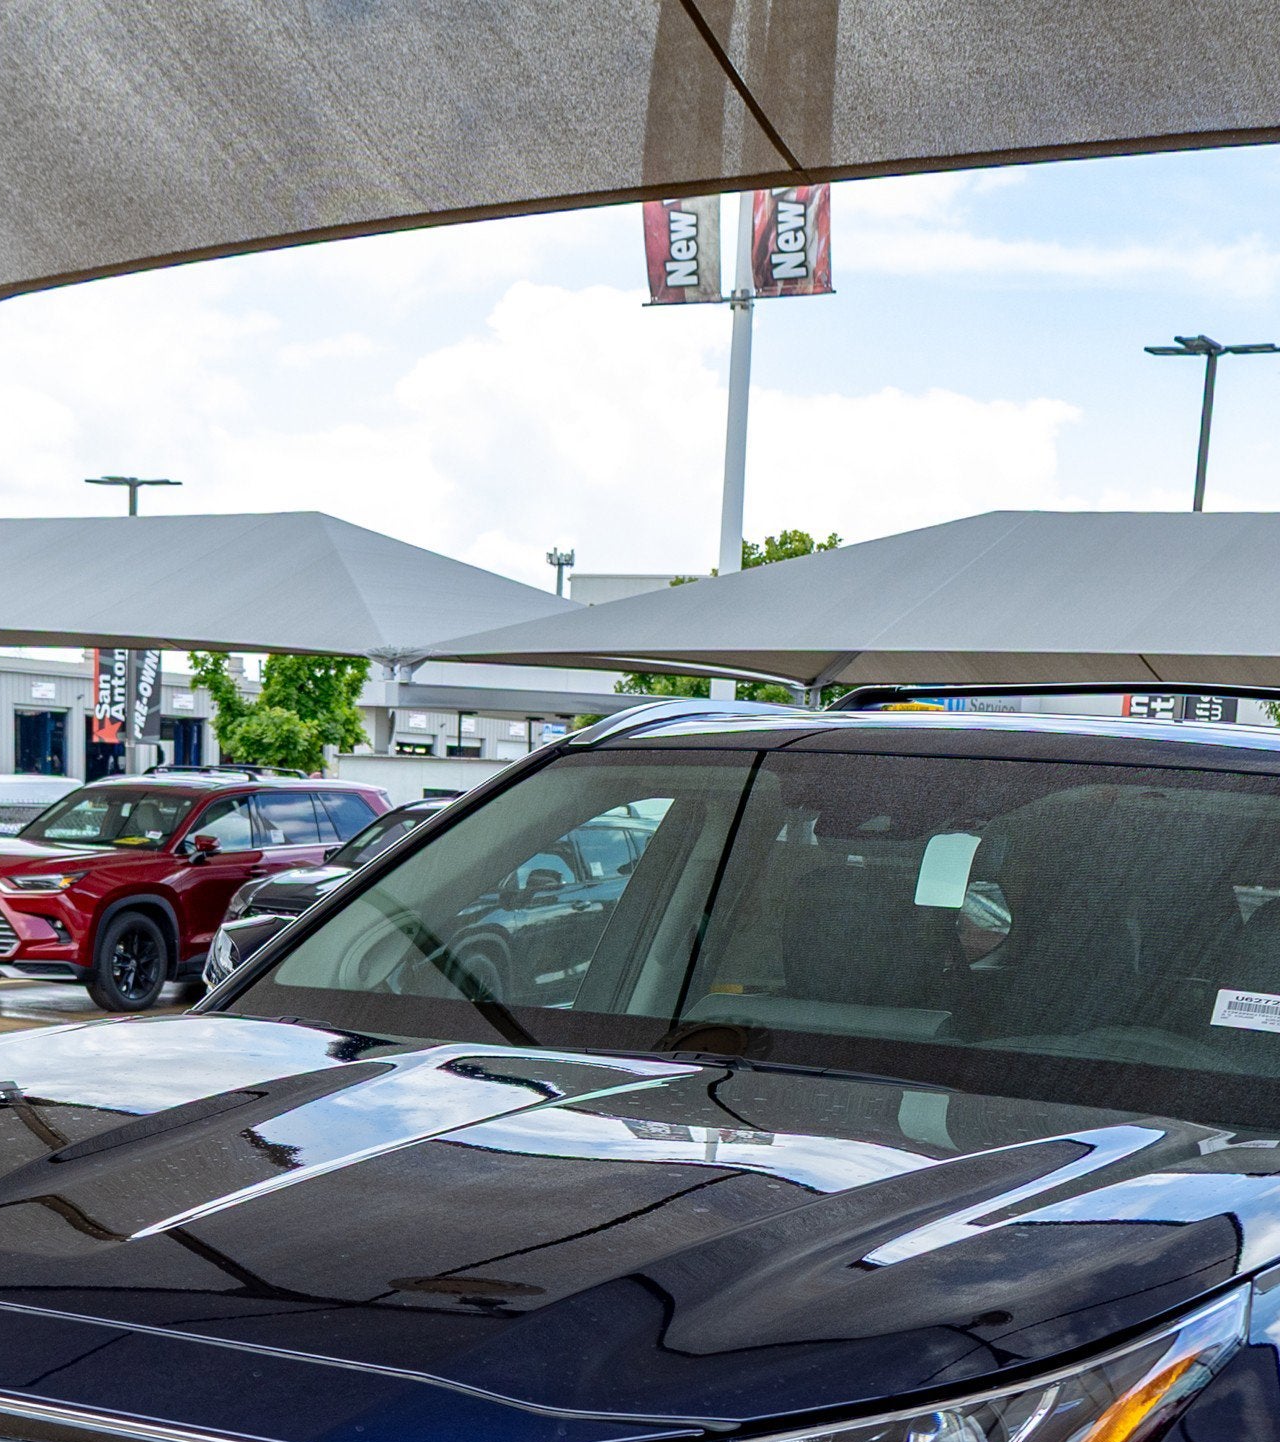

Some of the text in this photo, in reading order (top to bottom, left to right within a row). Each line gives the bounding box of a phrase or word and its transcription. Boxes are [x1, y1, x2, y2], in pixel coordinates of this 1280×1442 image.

[665, 211, 699, 287] New
[771, 202, 807, 280] New
[95, 674, 111, 720] San
[134, 650, 160, 739] PRE-OWN
